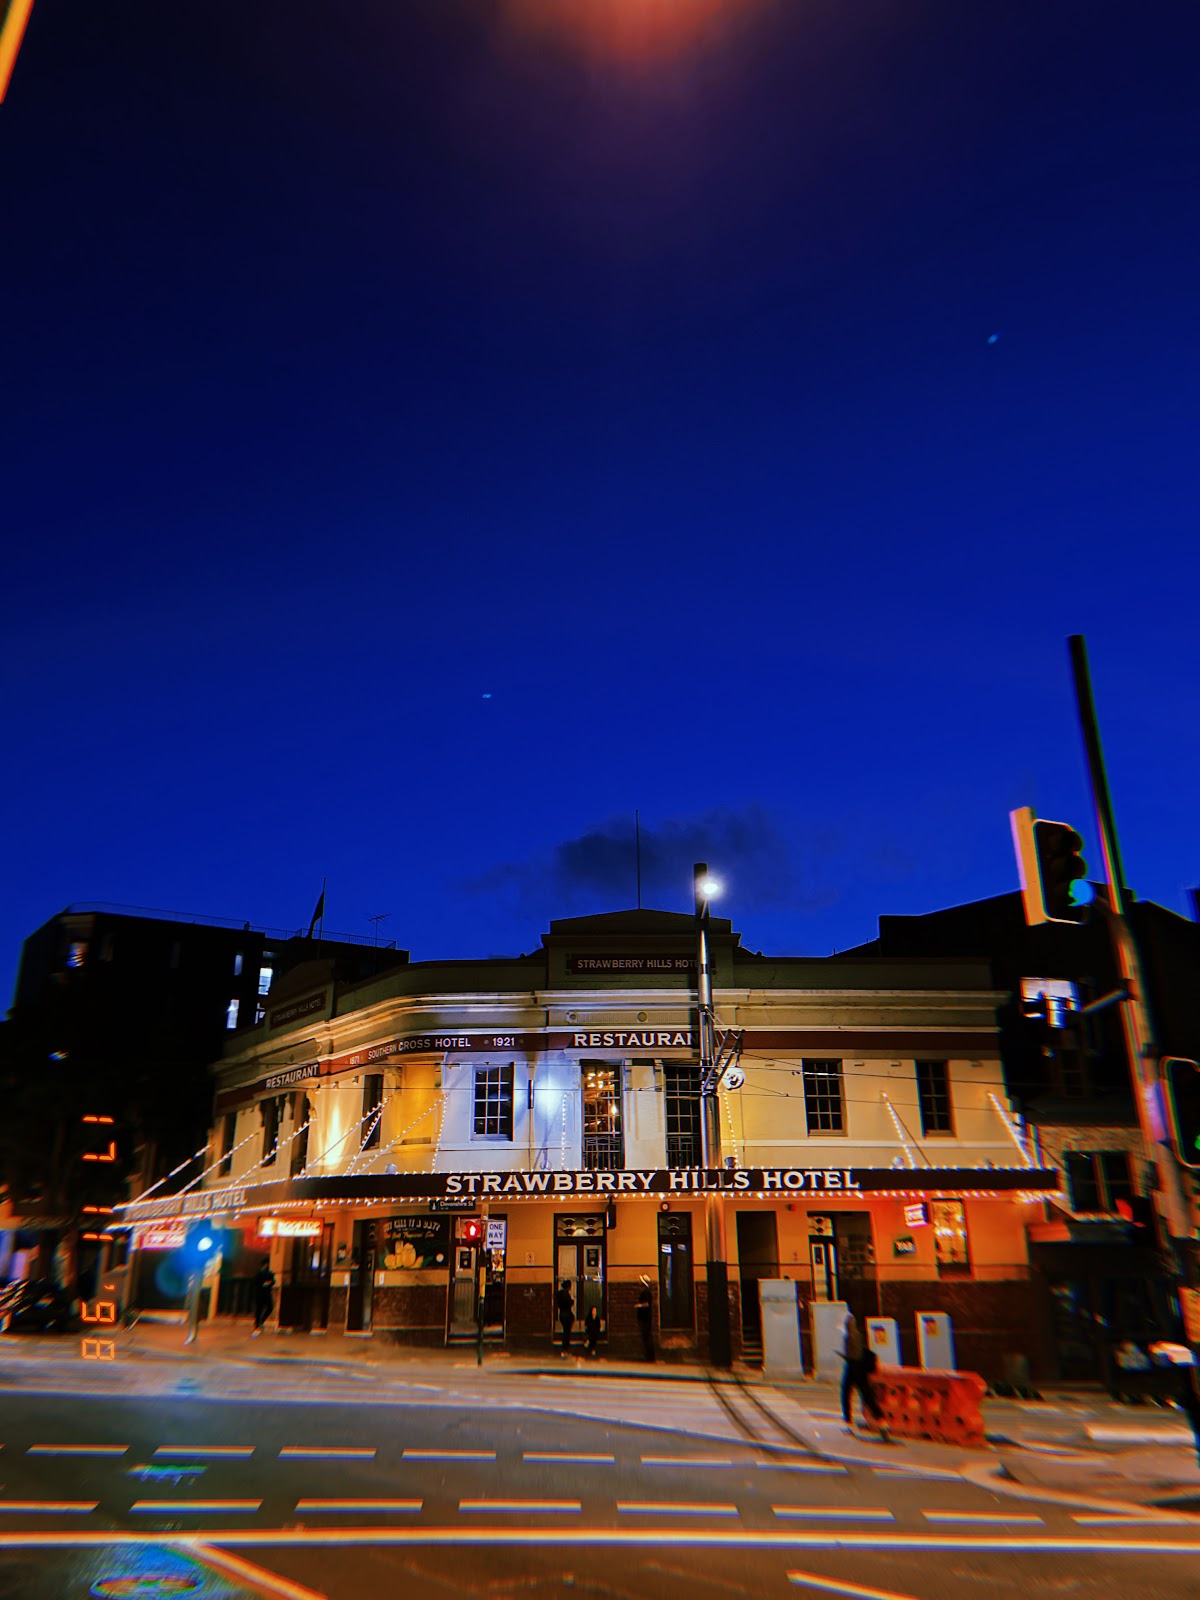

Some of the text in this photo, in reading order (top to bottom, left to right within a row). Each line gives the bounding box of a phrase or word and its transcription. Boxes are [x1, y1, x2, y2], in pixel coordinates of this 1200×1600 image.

[577, 959, 644, 968] STRAWBERRY
[646, 959, 672, 969] HILLS
[574, 1032, 700, 1046] RESTAURAN
[368, 1044, 397, 1060] SOUTHERN
[398, 1039, 431, 1051] CROSS
[435, 1037, 471, 1048] HOTEL
[492, 1037, 515, 1046] 1921
[266, 1064, 319, 1089] RESTAURANT
[445, 1170, 861, 1193] STRAWBERRY HILLS HOTEL
[212, 1189, 247, 1209] HOTEL
[488, 1231, 504, 1239] WAY
[489, 1223, 503, 1231] ONE
